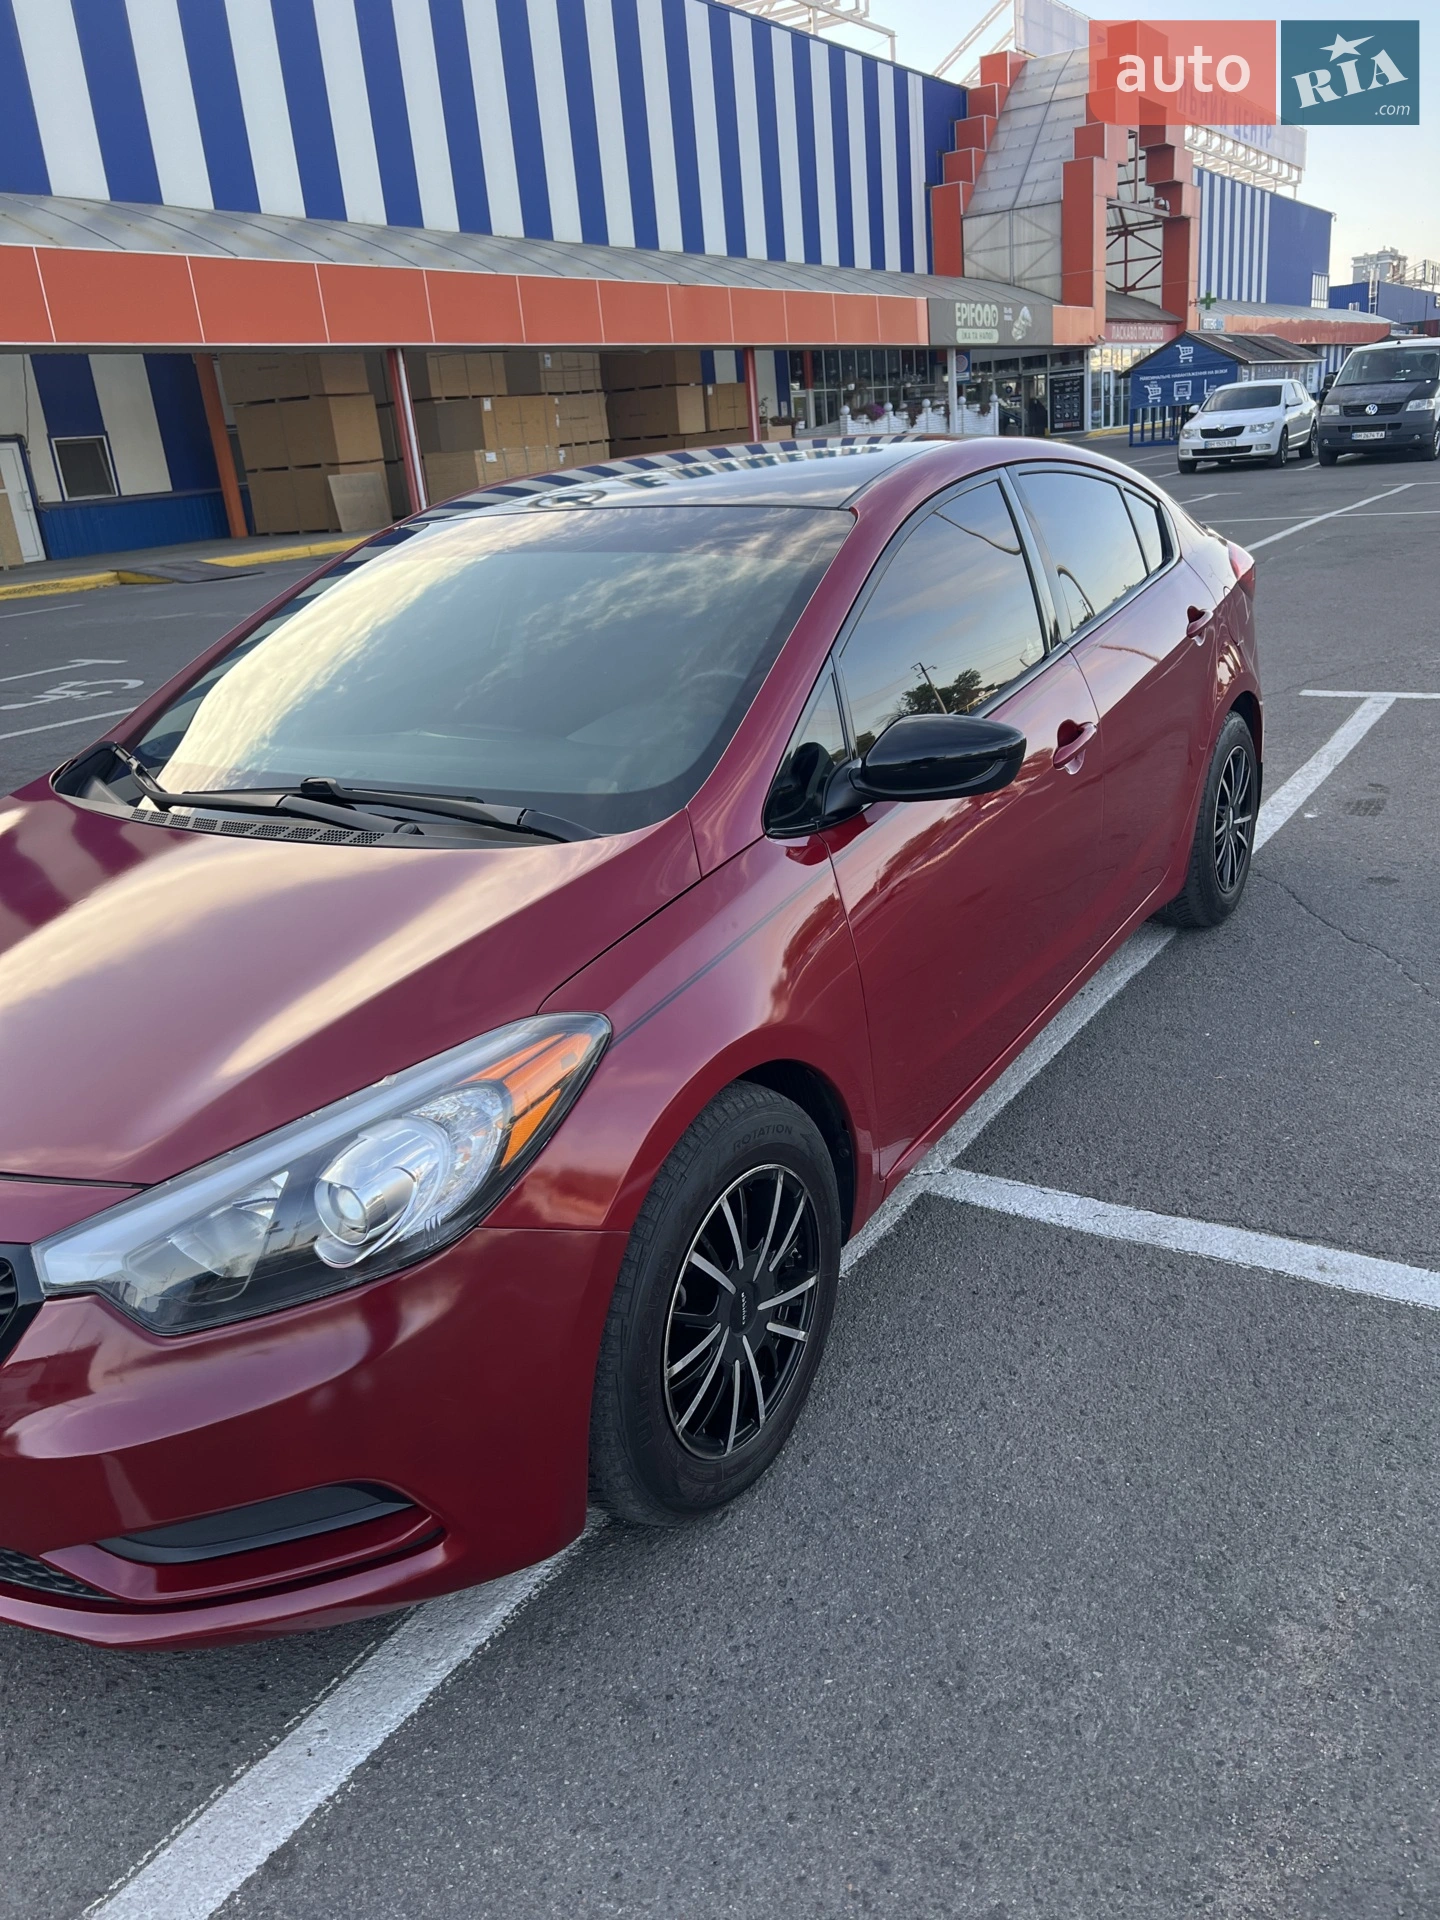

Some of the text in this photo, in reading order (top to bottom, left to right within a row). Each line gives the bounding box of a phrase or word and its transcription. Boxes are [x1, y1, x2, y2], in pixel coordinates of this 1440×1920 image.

[1234, 103, 1272, 149] ЦЕНТР
[955, 302, 999, 328] EPIFOOD
[1111, 325, 1164, 340] ЛАСКАВО ПРОСИМО
[1171, 371, 1207, 379] НАВАНТАЖЕННЯ
[733, 1123, 794, 1152] ROTATION
